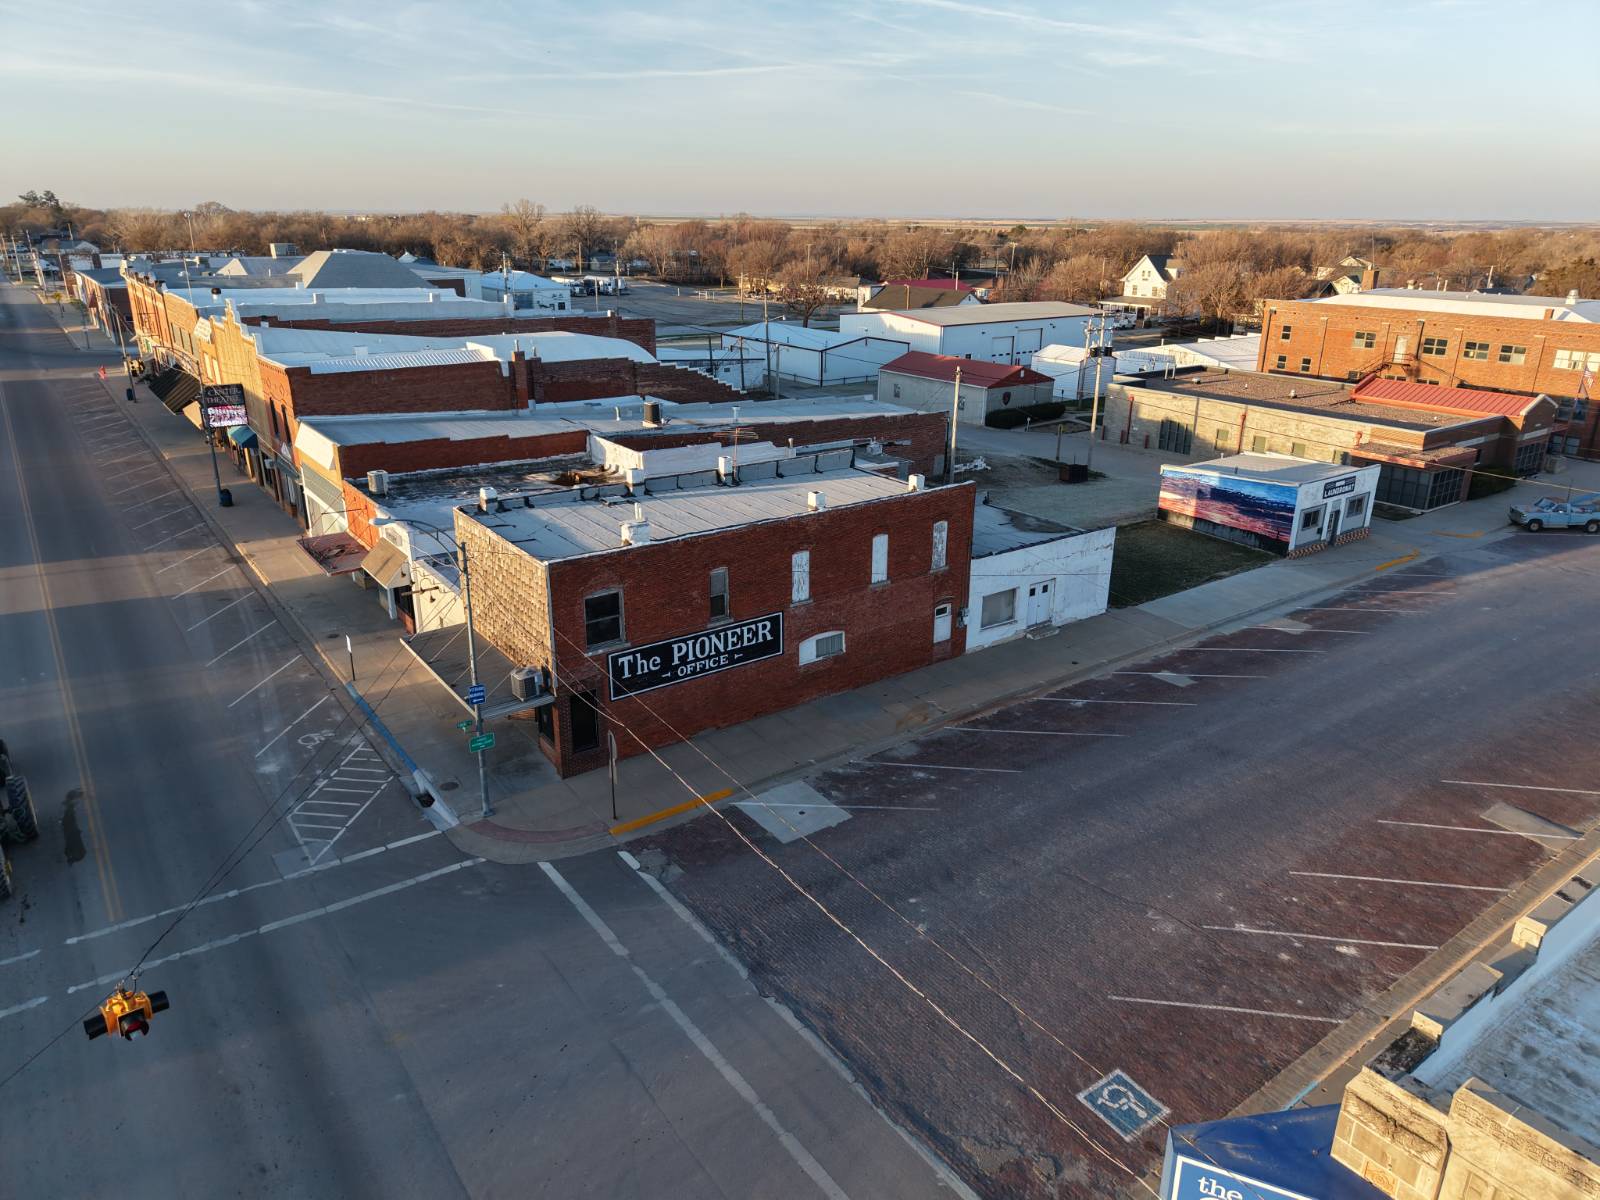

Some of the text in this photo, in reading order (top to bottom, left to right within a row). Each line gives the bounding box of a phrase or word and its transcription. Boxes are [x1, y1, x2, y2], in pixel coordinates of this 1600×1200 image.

[1324, 484, 1354, 497] LAUNDROMAT
[618, 620, 773, 679] The PIONEER
[677, 654, 729, 677] OFFICE
[1197, 1176, 1243, 1200] the
